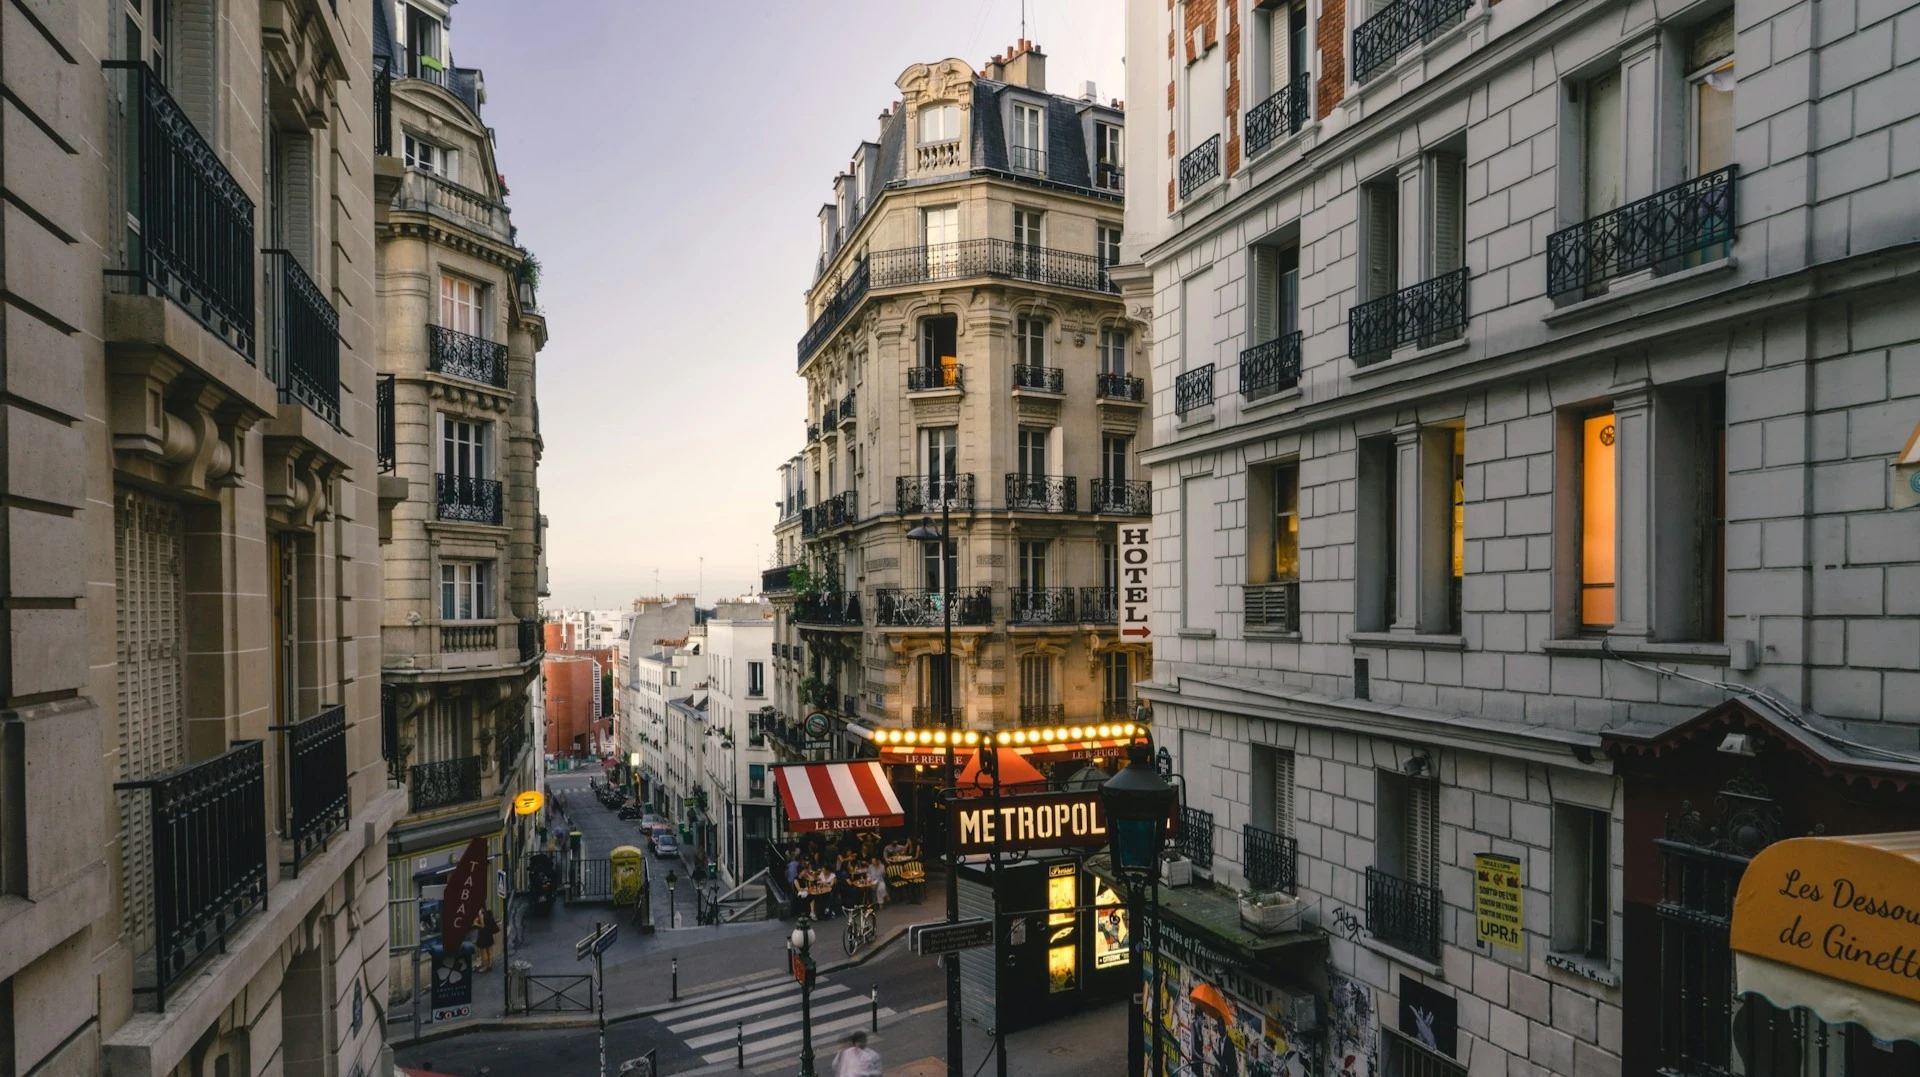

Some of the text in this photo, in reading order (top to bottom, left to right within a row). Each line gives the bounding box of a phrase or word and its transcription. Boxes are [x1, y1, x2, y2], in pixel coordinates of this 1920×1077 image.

[1122, 529, 1149, 622] HOTEL
[905, 755, 963, 765] LE REFUE
[1072, 751, 1084, 760] LE
[814, 818, 880, 830] LE REFUGE
[960, 802, 1170, 845] METROPOL
[453, 861, 479, 928] TABAC
[1480, 885, 1498, 896] SORTIR
[1779, 869, 1824, 902] Les
[1480, 897, 1495, 907] SORTIR
[1480, 908, 1496, 918] SORTIR
[1496, 911, 1502, 919] DE
[1158, 919, 1183, 945] lorales
[1184, 937, 1192, 950] et
[1779, 915, 1814, 949] de
